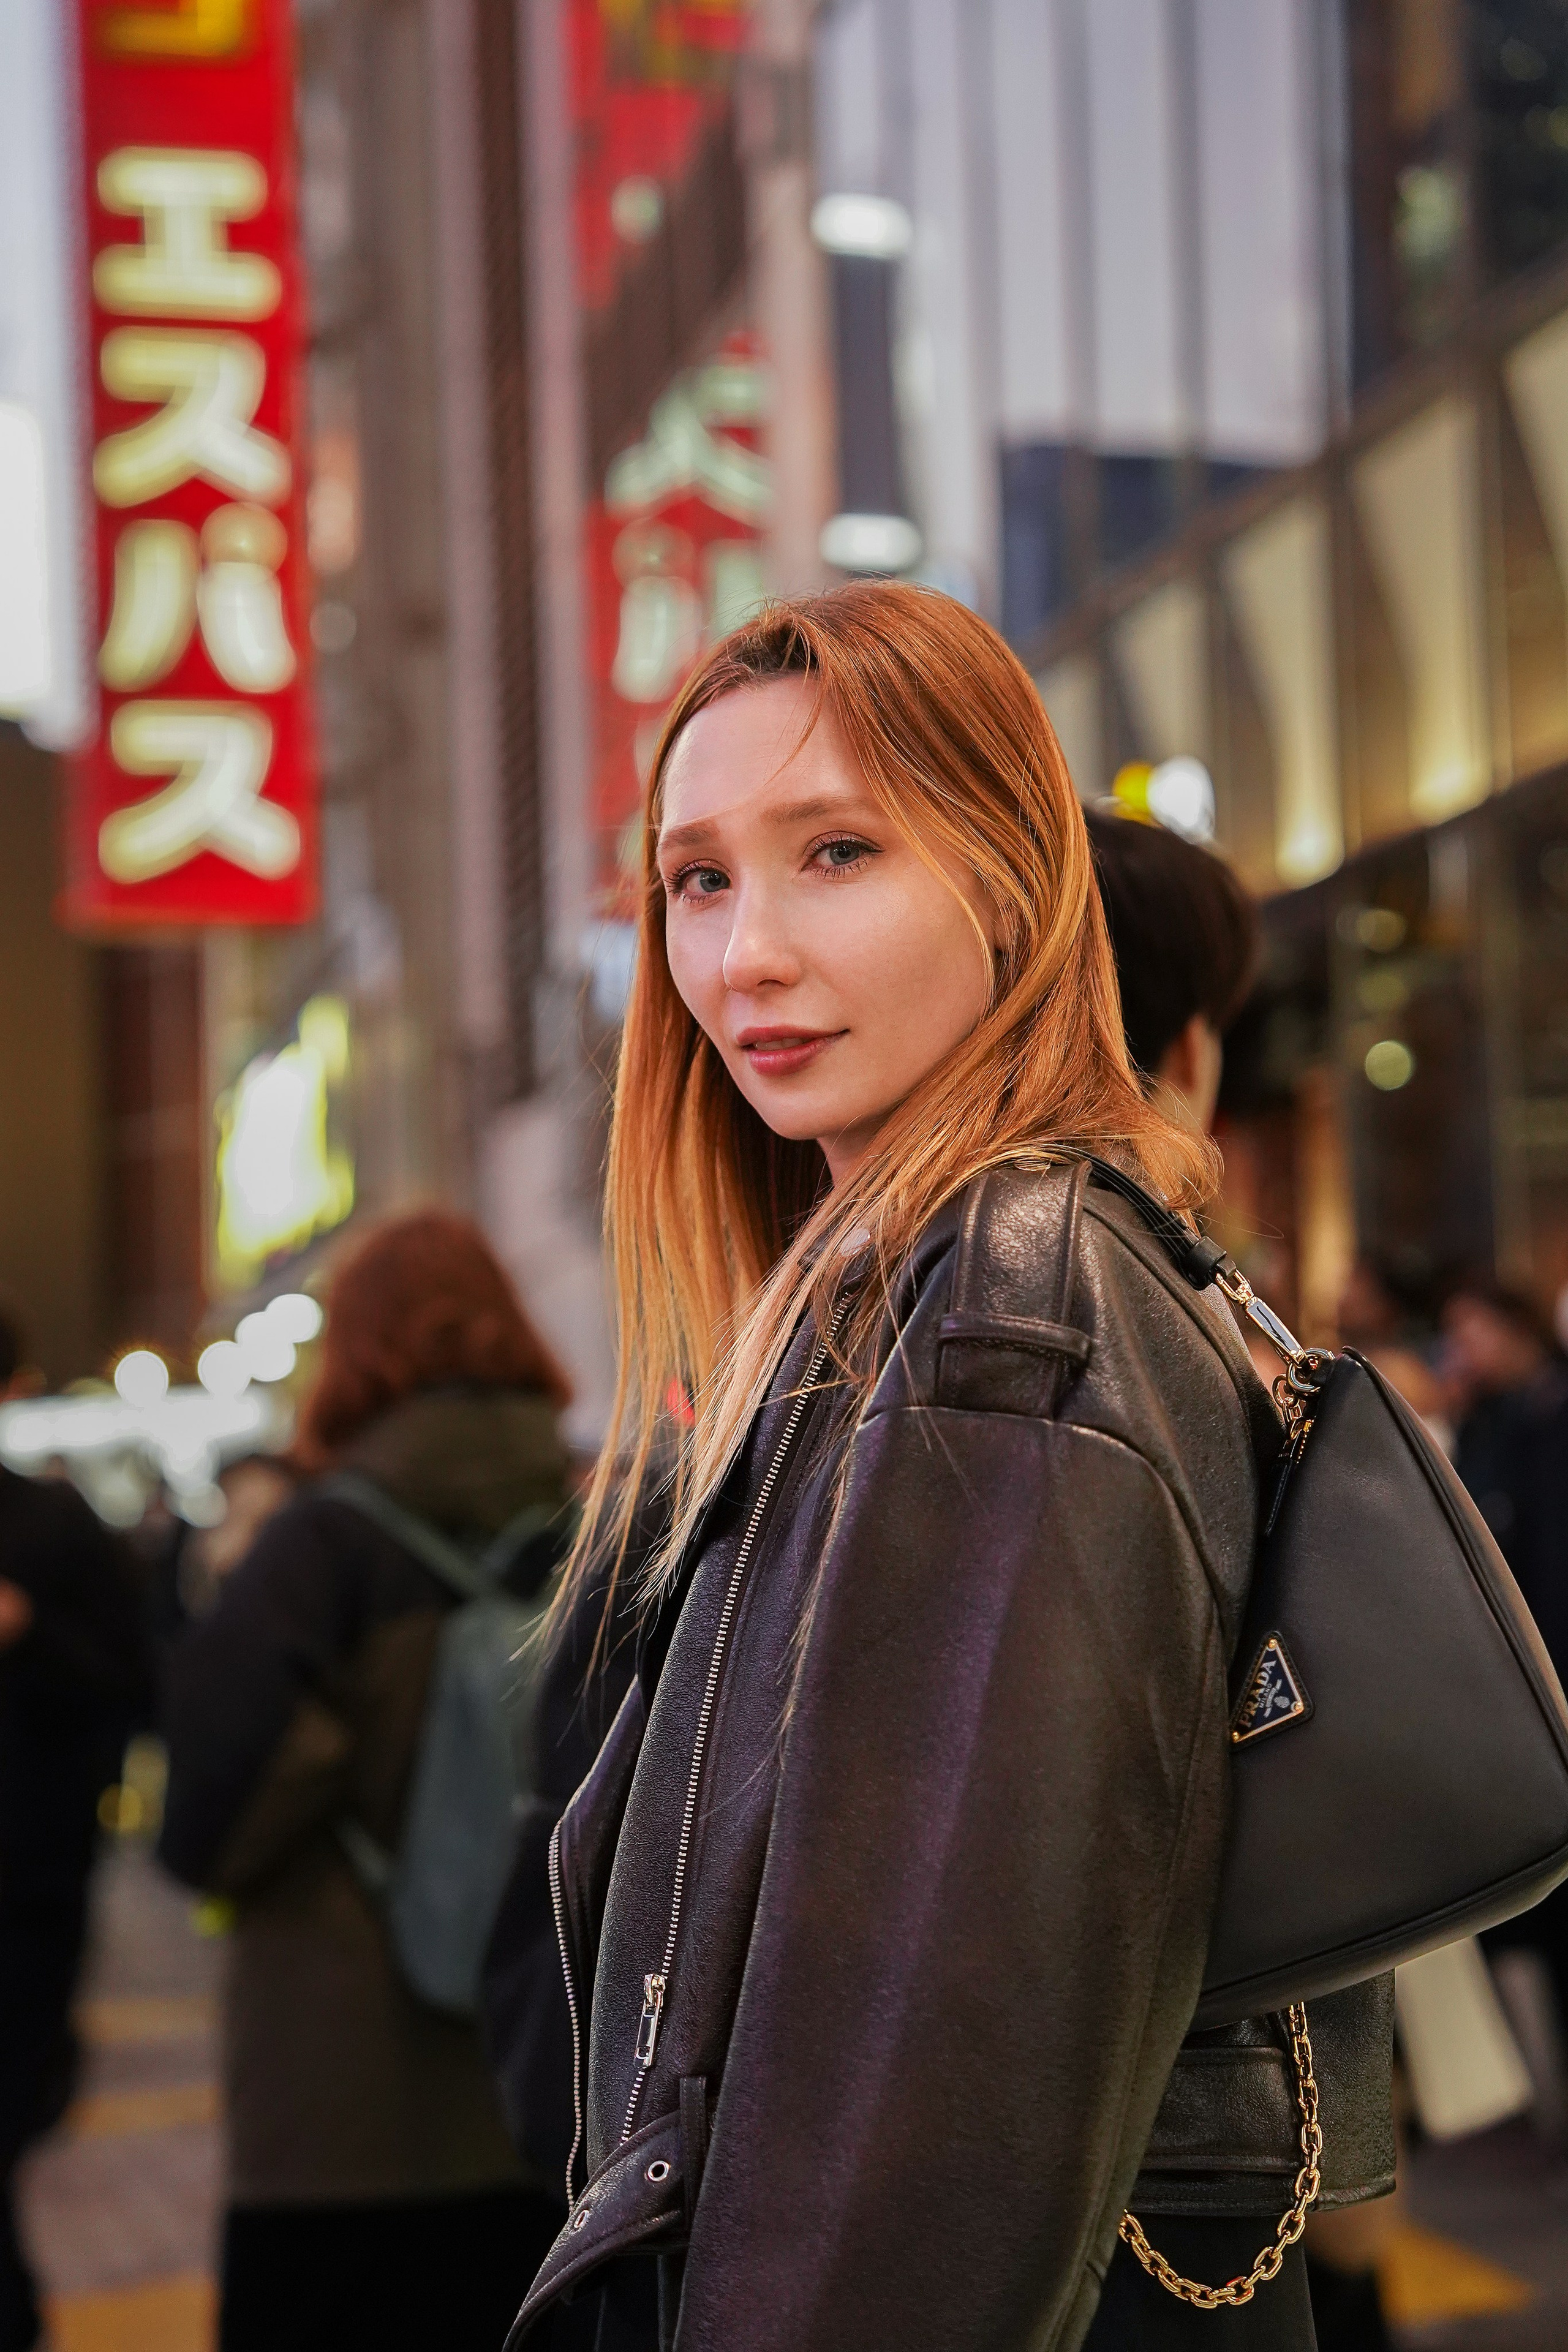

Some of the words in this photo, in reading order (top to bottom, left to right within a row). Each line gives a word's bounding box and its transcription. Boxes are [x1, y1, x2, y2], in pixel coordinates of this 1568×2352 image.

[92, 145, 300, 884] エスパス
[1238, 1660, 1276, 1728] PRADA
[1259, 1683, 1273, 1709] MILANO
